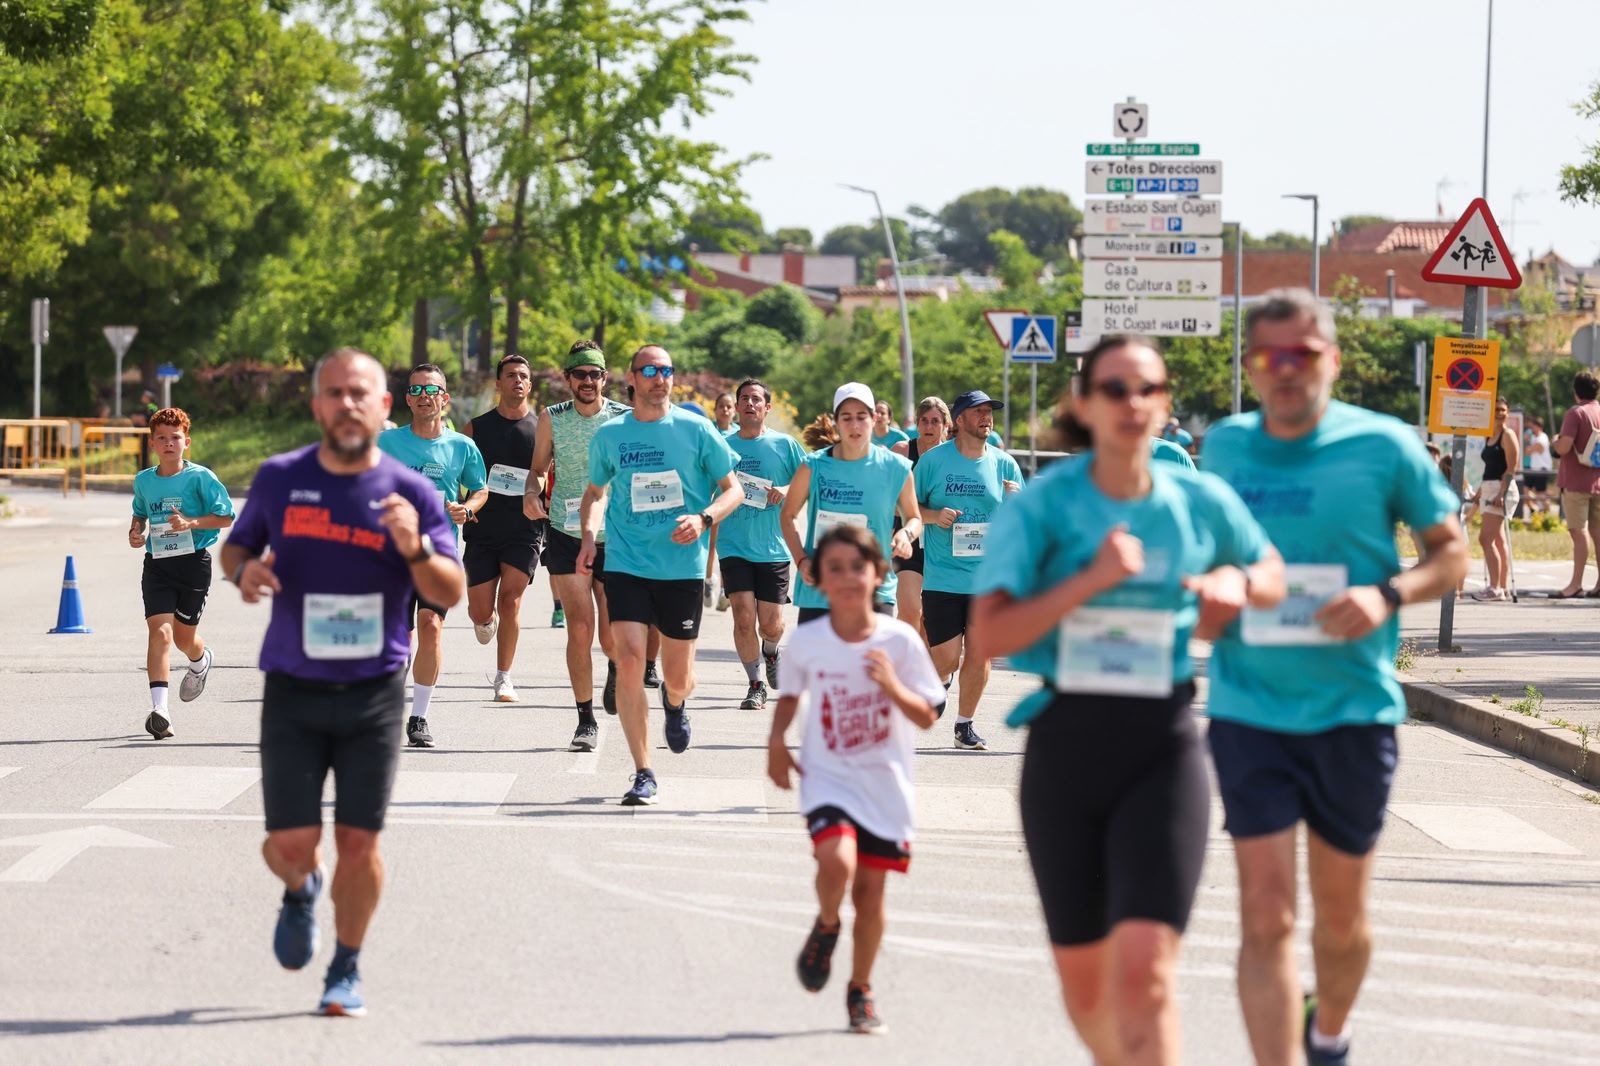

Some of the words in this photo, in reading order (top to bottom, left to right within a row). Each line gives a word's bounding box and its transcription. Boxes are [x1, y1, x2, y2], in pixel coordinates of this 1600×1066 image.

[1110, 144, 1155, 154] Salvador
[1161, 144, 1194, 155] Espriu
[1108, 162, 1144, 174] Totes
[1149, 162, 1216, 174] Direccions
[1108, 181, 1132, 191] E-15
[1138, 180, 1165, 191] AP-7
[1171, 180, 1197, 191] B-30
[1105, 200, 1148, 214] Estació
[1151, 201, 1178, 214] Sant
[1182, 201, 1216, 217] Cugat
[1105, 241, 1151, 250] Monestir
[1105, 262, 1138, 276] Casa
[1105, 279, 1120, 291] de
[1126, 279, 1172, 291] Cultura
[1104, 303, 1138, 314] Hotel
[1104, 318, 1118, 329] St.
[1123, 318, 1156, 332] Cugat
[620, 451, 640, 465] KM
[820, 487, 838, 500] KM
[945, 483, 964, 493] KM
[650, 494, 666, 503] 119
[164, 543, 178, 551] 482
[967, 543, 981, 551] 474
